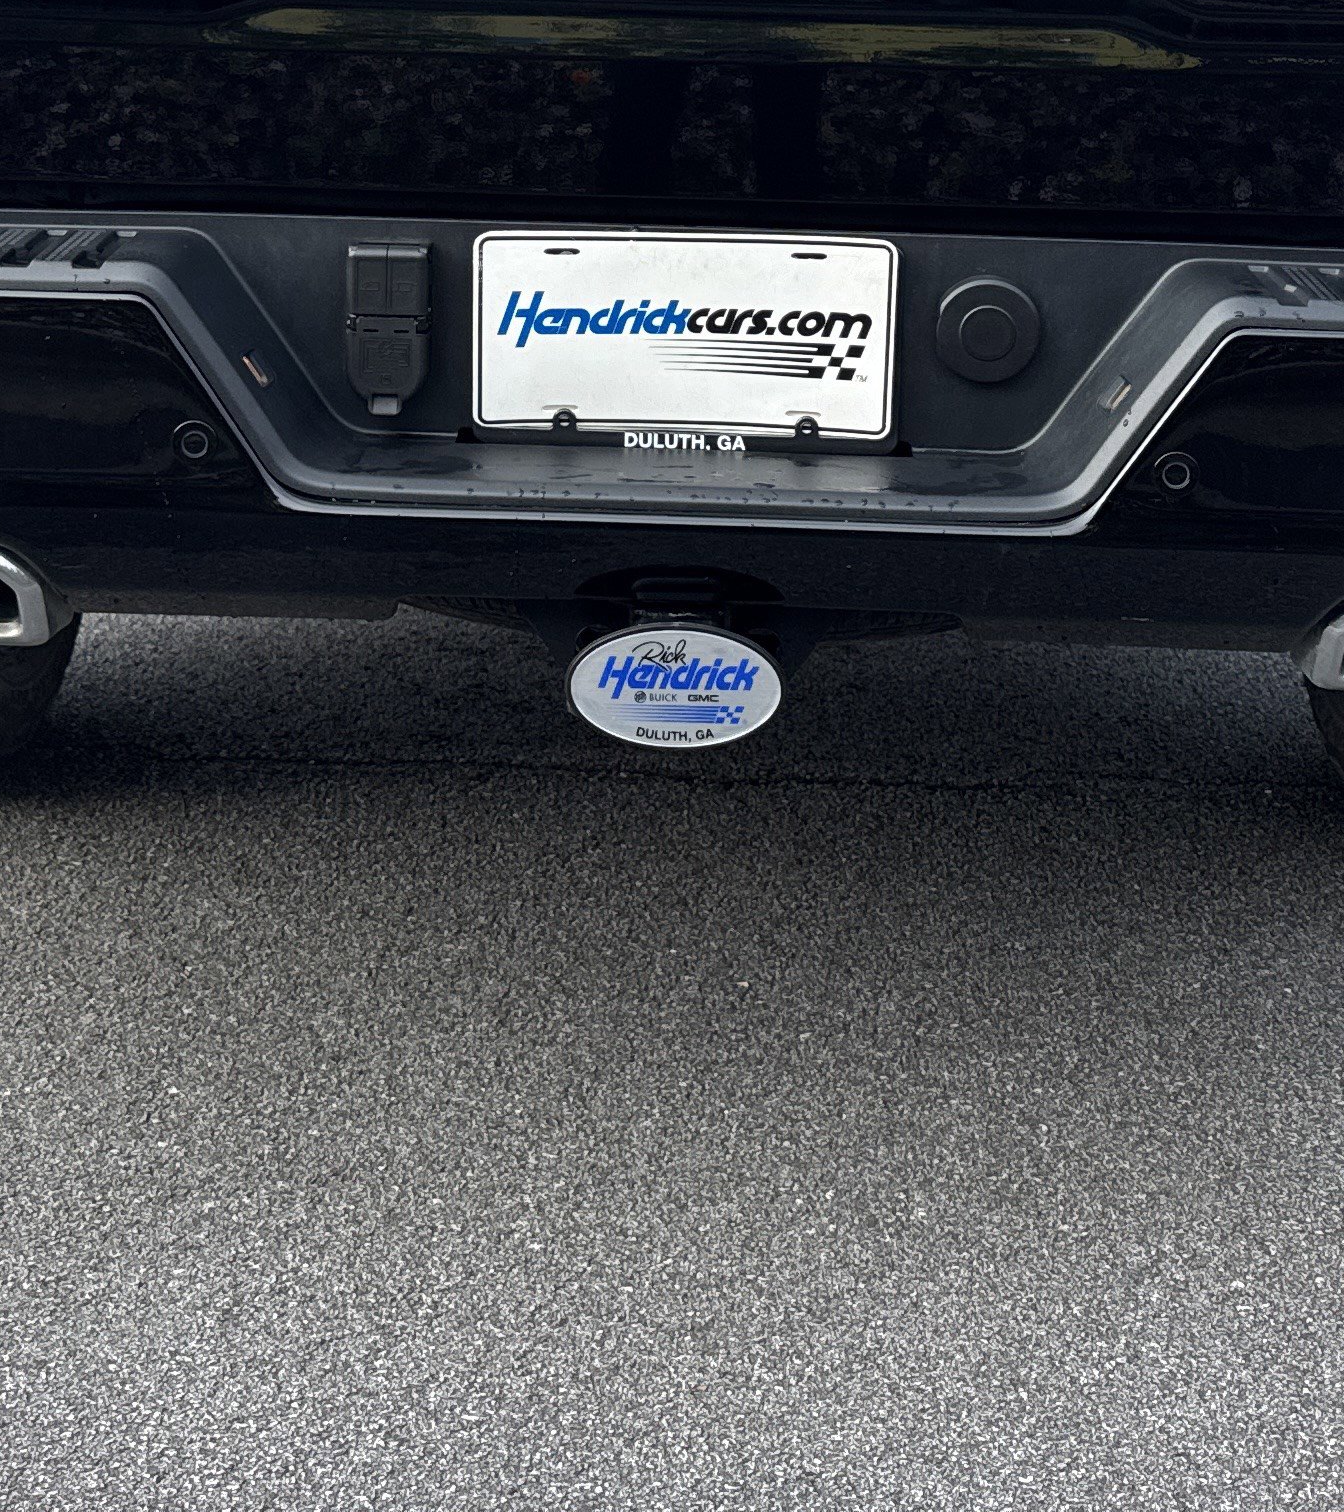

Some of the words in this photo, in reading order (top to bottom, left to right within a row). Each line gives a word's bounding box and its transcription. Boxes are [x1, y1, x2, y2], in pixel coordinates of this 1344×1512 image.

[497, 290, 873, 348] Hendrickcars.com
[717, 434, 746, 451] GA
[632, 639, 687, 671] Rick
[598, 655, 759, 700] Hendrick
[649, 692, 678, 702] BUICK
[687, 694, 720, 702] GMC
[636, 726, 692, 743] DULUTH,
[695, 728, 715, 740] GA
